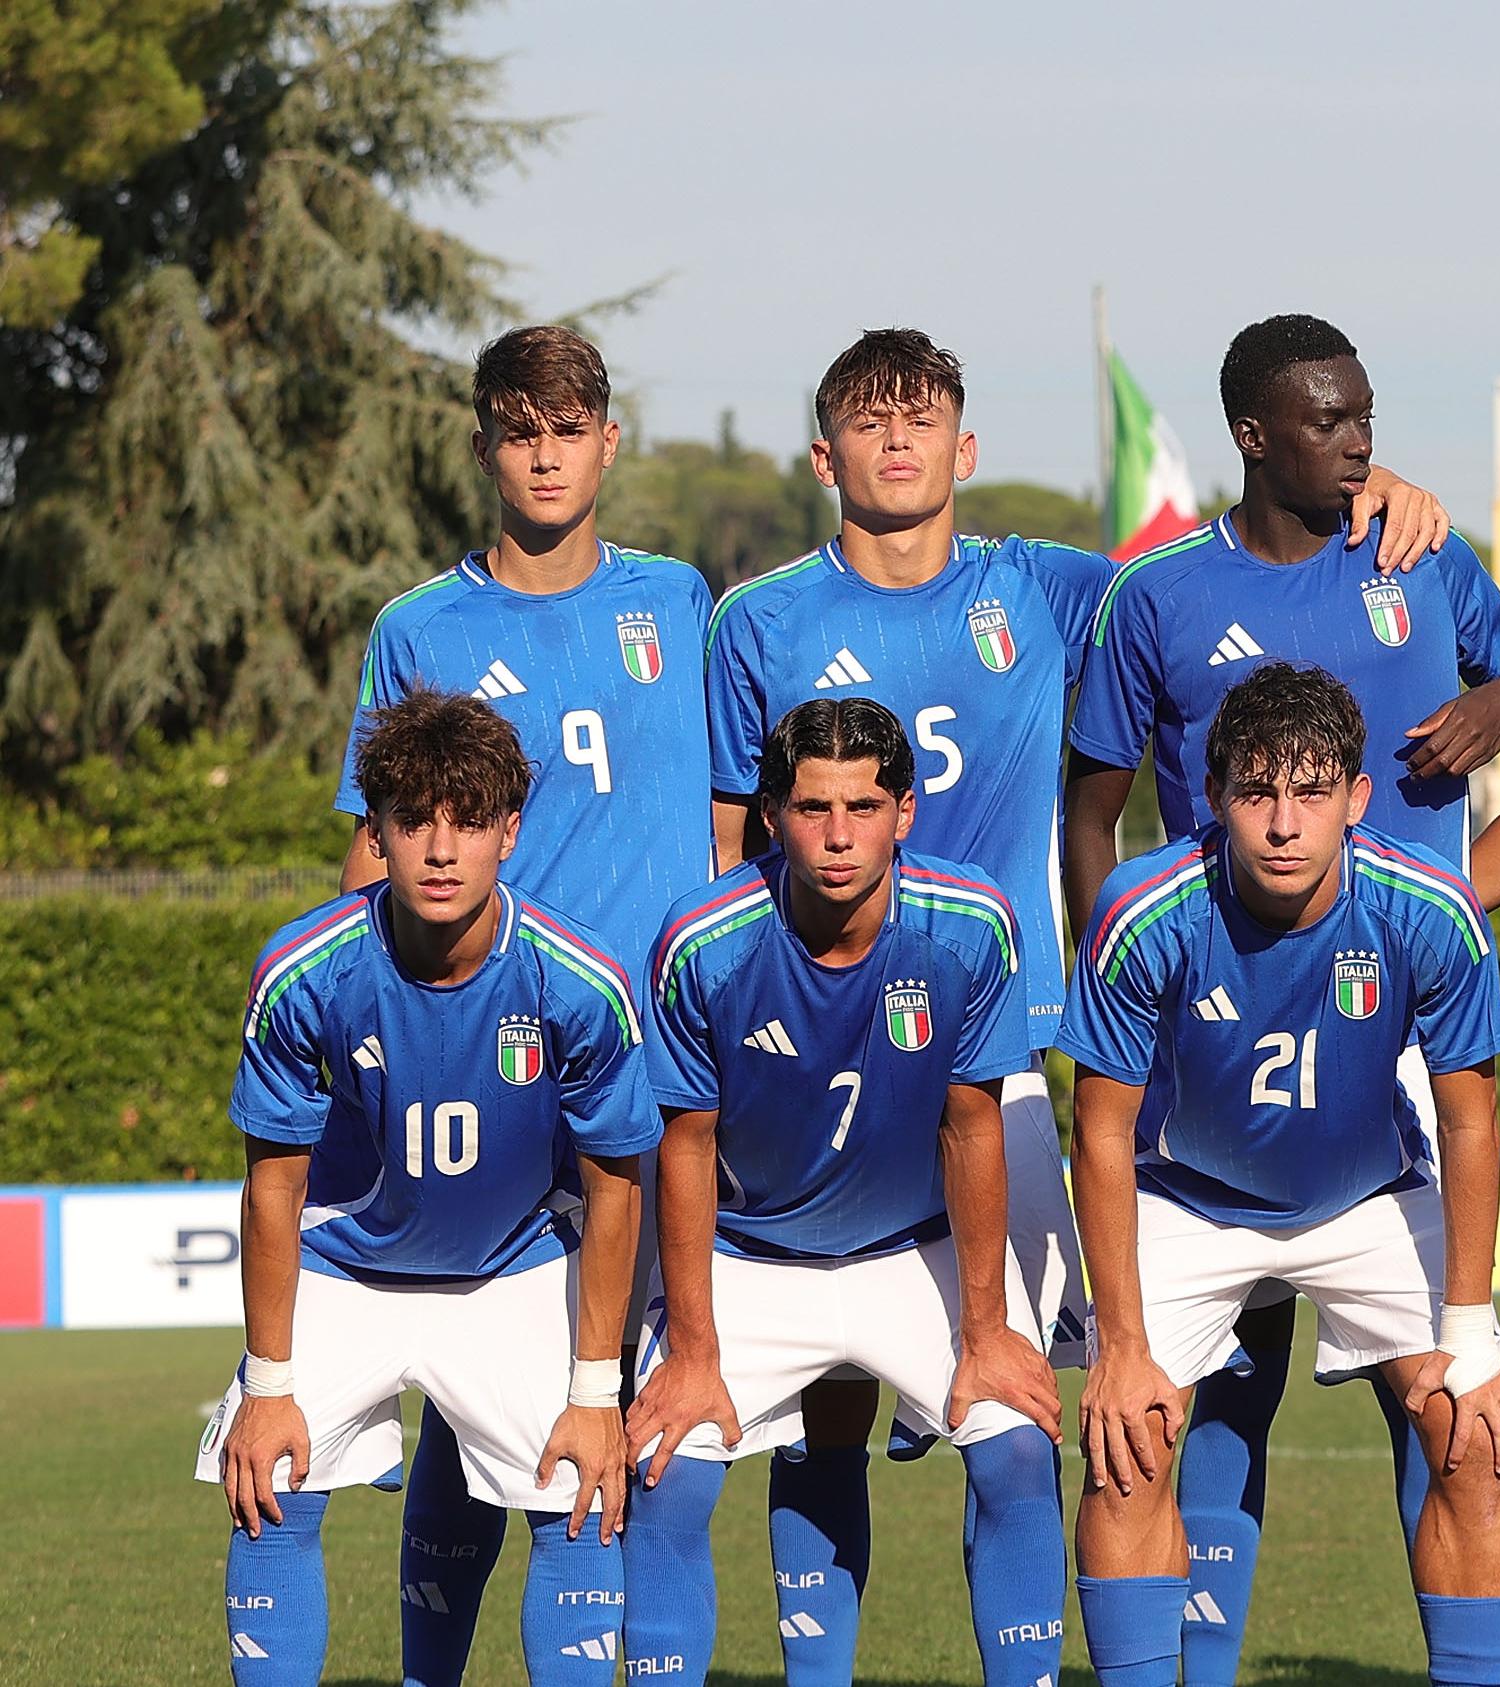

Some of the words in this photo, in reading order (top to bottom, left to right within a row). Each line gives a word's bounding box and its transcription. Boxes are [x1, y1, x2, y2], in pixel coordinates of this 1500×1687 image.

[1367, 591, 1402, 608] ITALIA
[972, 612, 1005, 632] ITALIA
[623, 627, 654, 640] ITALIA
[562, 710, 611, 794] 9
[915, 705, 963, 794] 5
[1339, 965, 1375, 978] ITALIA
[889, 994, 926, 1009] ITALIA
[1029, 1004, 1063, 1017] HEAT.RD
[502, 1030, 539, 1043] ITALIA
[1250, 1028, 1317, 1109] 21
[828, 1072, 861, 1151] 7
[406, 1101, 479, 1178] 10
[638, 1295, 667, 1377] 7
[558, 1590, 625, 1606] ITALIA
[998, 1619, 1063, 1646] ITALIA
